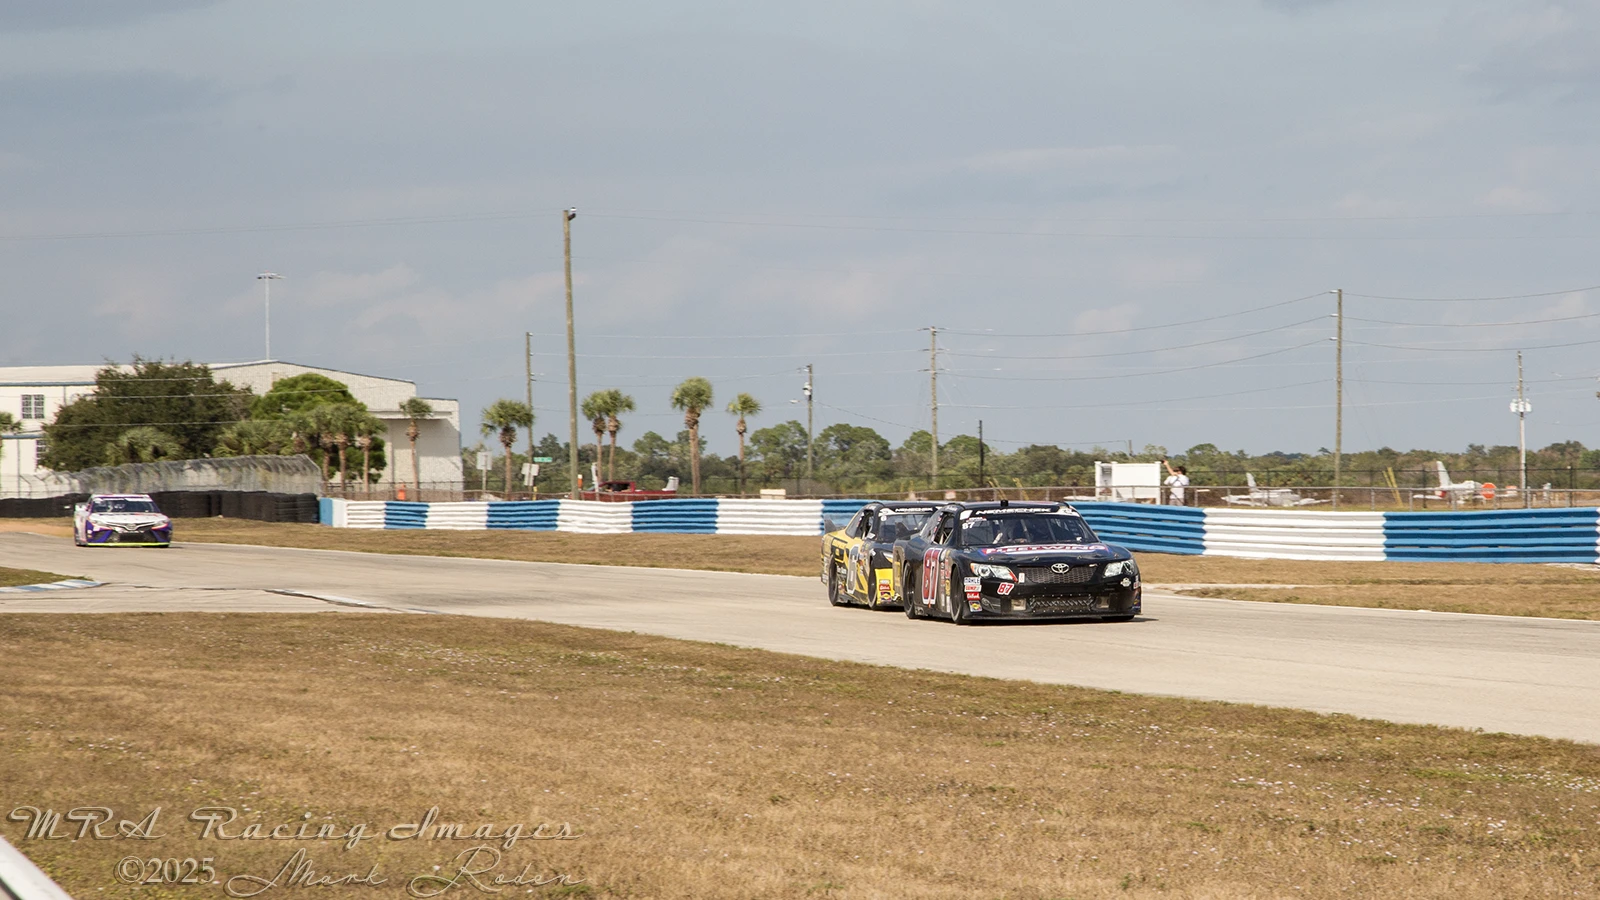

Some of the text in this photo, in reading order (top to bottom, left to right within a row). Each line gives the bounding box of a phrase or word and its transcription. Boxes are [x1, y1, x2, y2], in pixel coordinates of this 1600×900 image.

[961, 522, 975, 530] 87
[922, 547, 942, 605] 87
[997, 582, 1014, 595] 87
